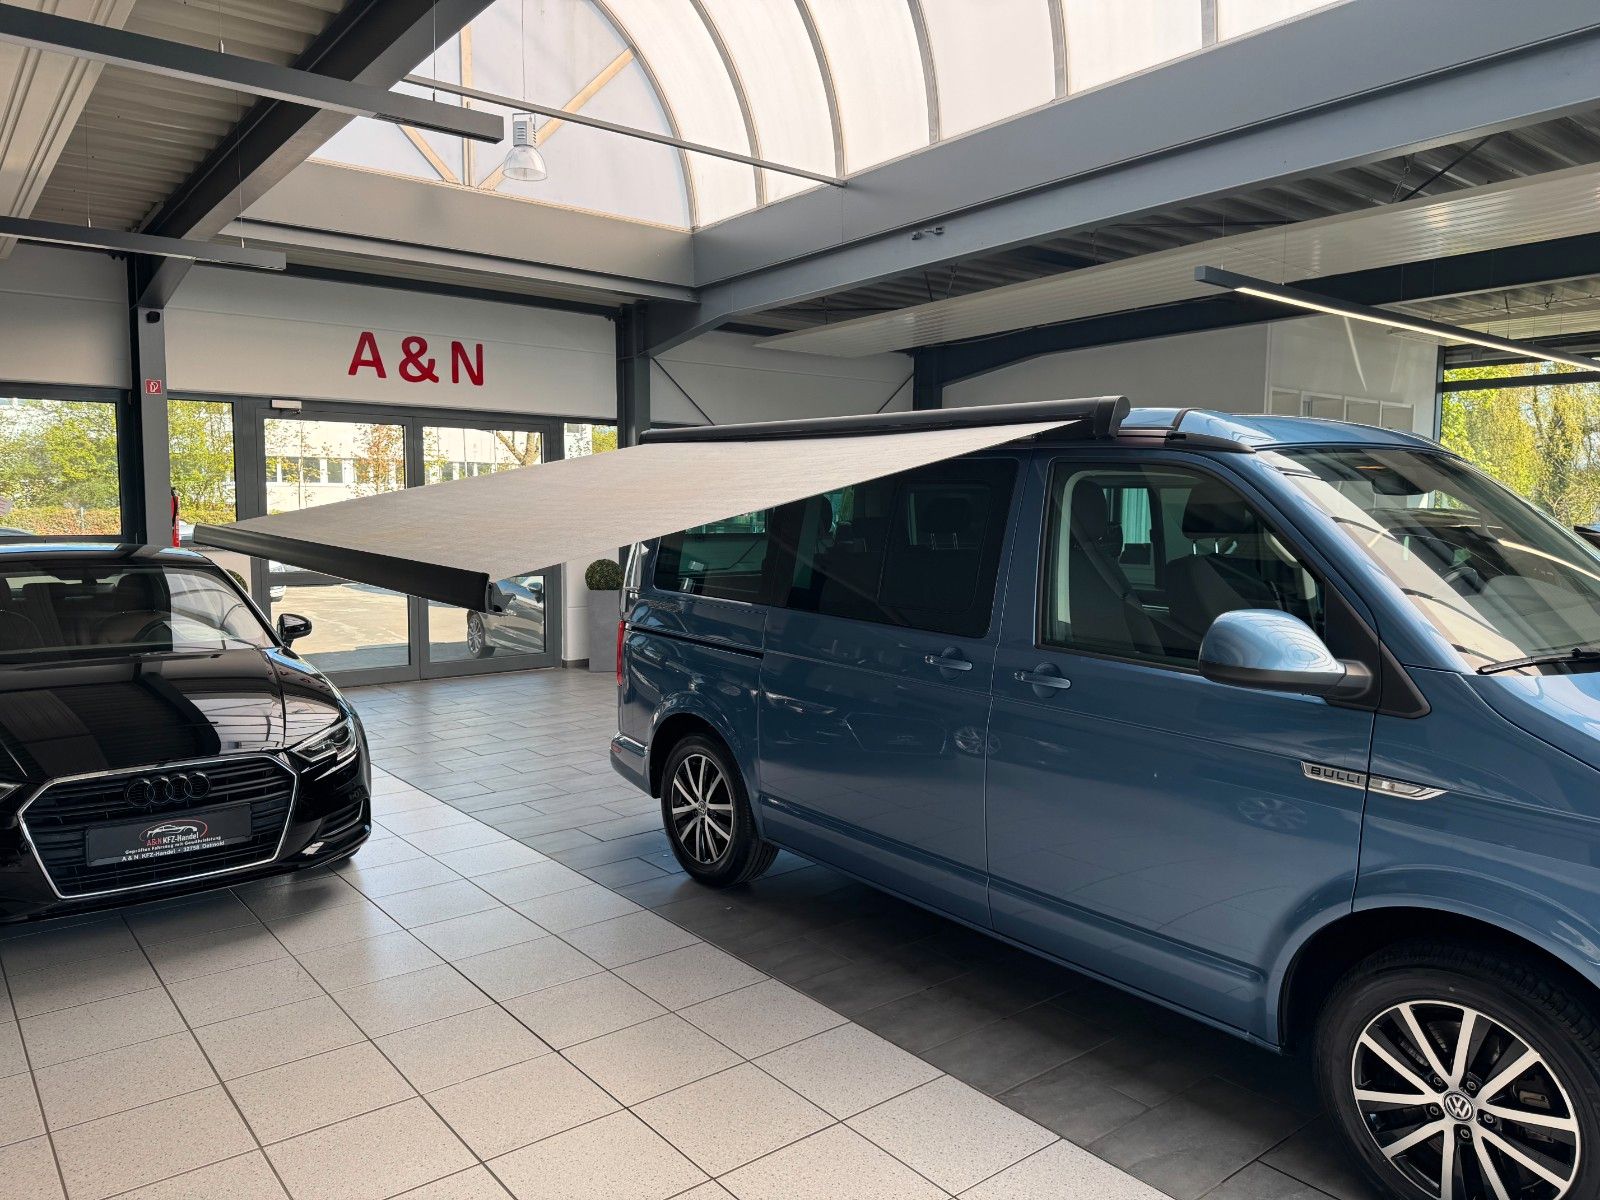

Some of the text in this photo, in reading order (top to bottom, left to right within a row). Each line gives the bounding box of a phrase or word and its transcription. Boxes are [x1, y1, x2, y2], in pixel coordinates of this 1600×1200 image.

[1310, 765, 1361, 784] BULLI
[162, 831, 199, 844] KFZ-Handel
[141, 848, 176, 859] KFZ-Handel
